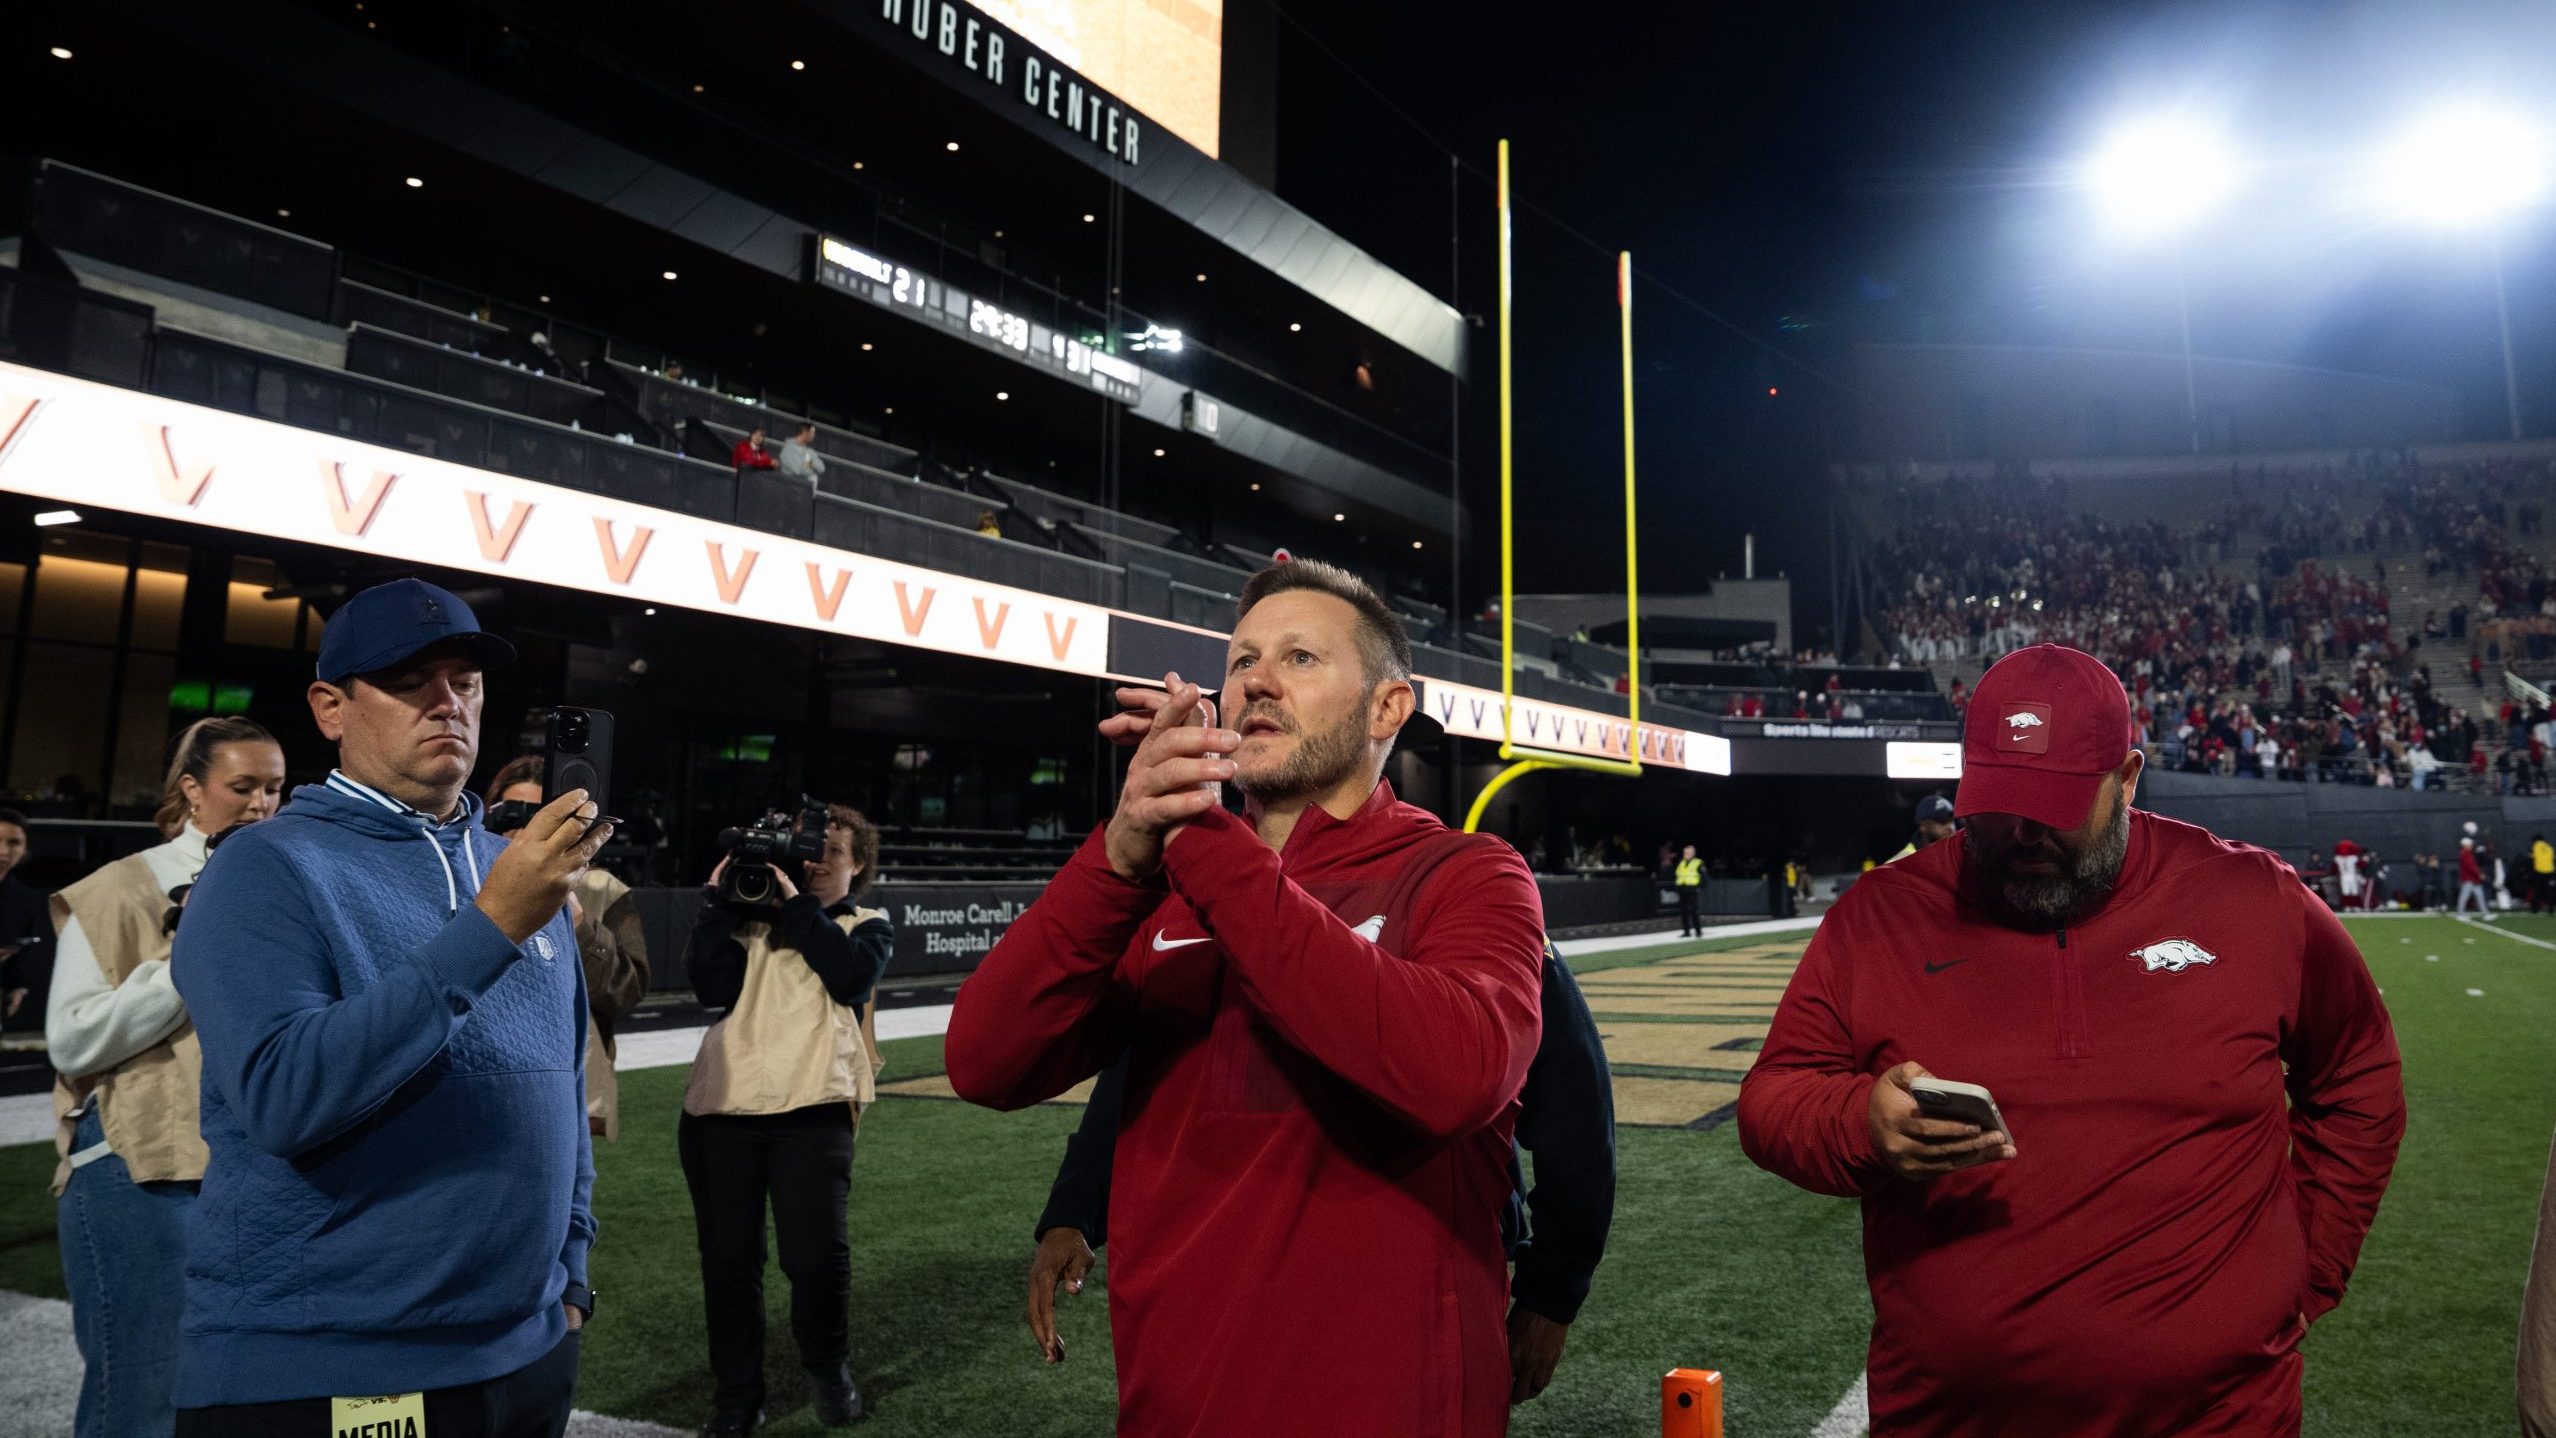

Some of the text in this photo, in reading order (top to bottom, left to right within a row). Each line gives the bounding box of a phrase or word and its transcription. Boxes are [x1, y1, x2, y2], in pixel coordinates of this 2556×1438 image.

[1024, 56, 1139, 165] CENTER
[893, 268, 925, 306] 21
[320, 460, 404, 536] V
[465, 490, 539, 563] V
[593, 517, 655, 585] V
[705, 541, 760, 604] V
[805, 562, 853, 621] V
[893, 580, 937, 637] V
[973, 597, 1010, 649] V
[1044, 613, 1077, 661] V
[1440, 693, 1455, 724] V
[1471, 699, 1485, 730] V
[1527, 710, 1540, 738] V
[1552, 715, 1565, 742] V
[1576, 719, 1587, 746] V
[904, 904, 965, 926] Monroe
[967, 901, 1012, 924] Carell
[926, 929, 990, 957] Hospital
